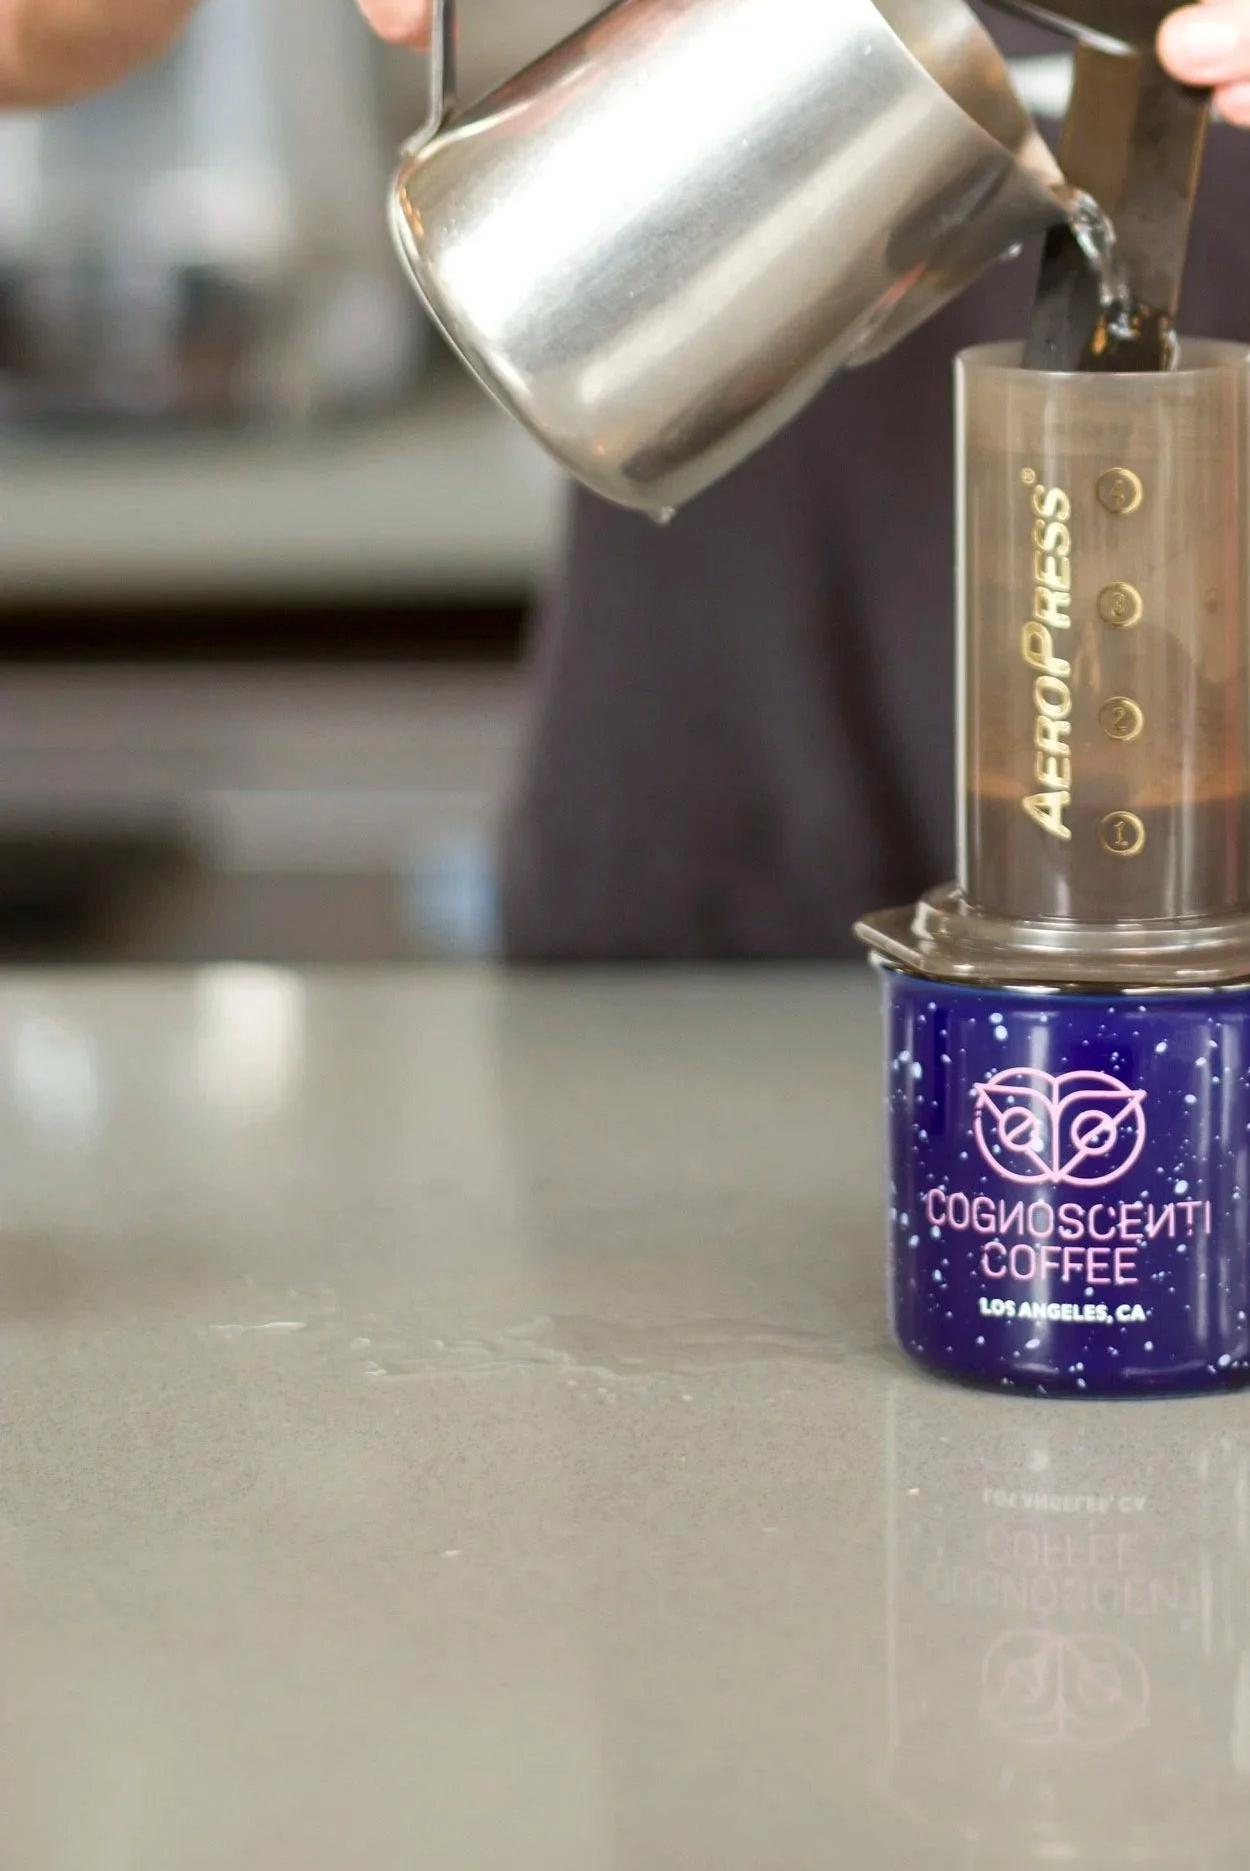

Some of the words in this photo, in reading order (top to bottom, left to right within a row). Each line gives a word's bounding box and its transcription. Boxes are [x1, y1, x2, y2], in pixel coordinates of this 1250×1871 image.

[980, 1240, 1139, 1285] COFFEE
[978, 1296, 1017, 1318] LOS
[1017, 1301, 1115, 1325] ANGELES,
[1115, 1303, 1148, 1323] CA
